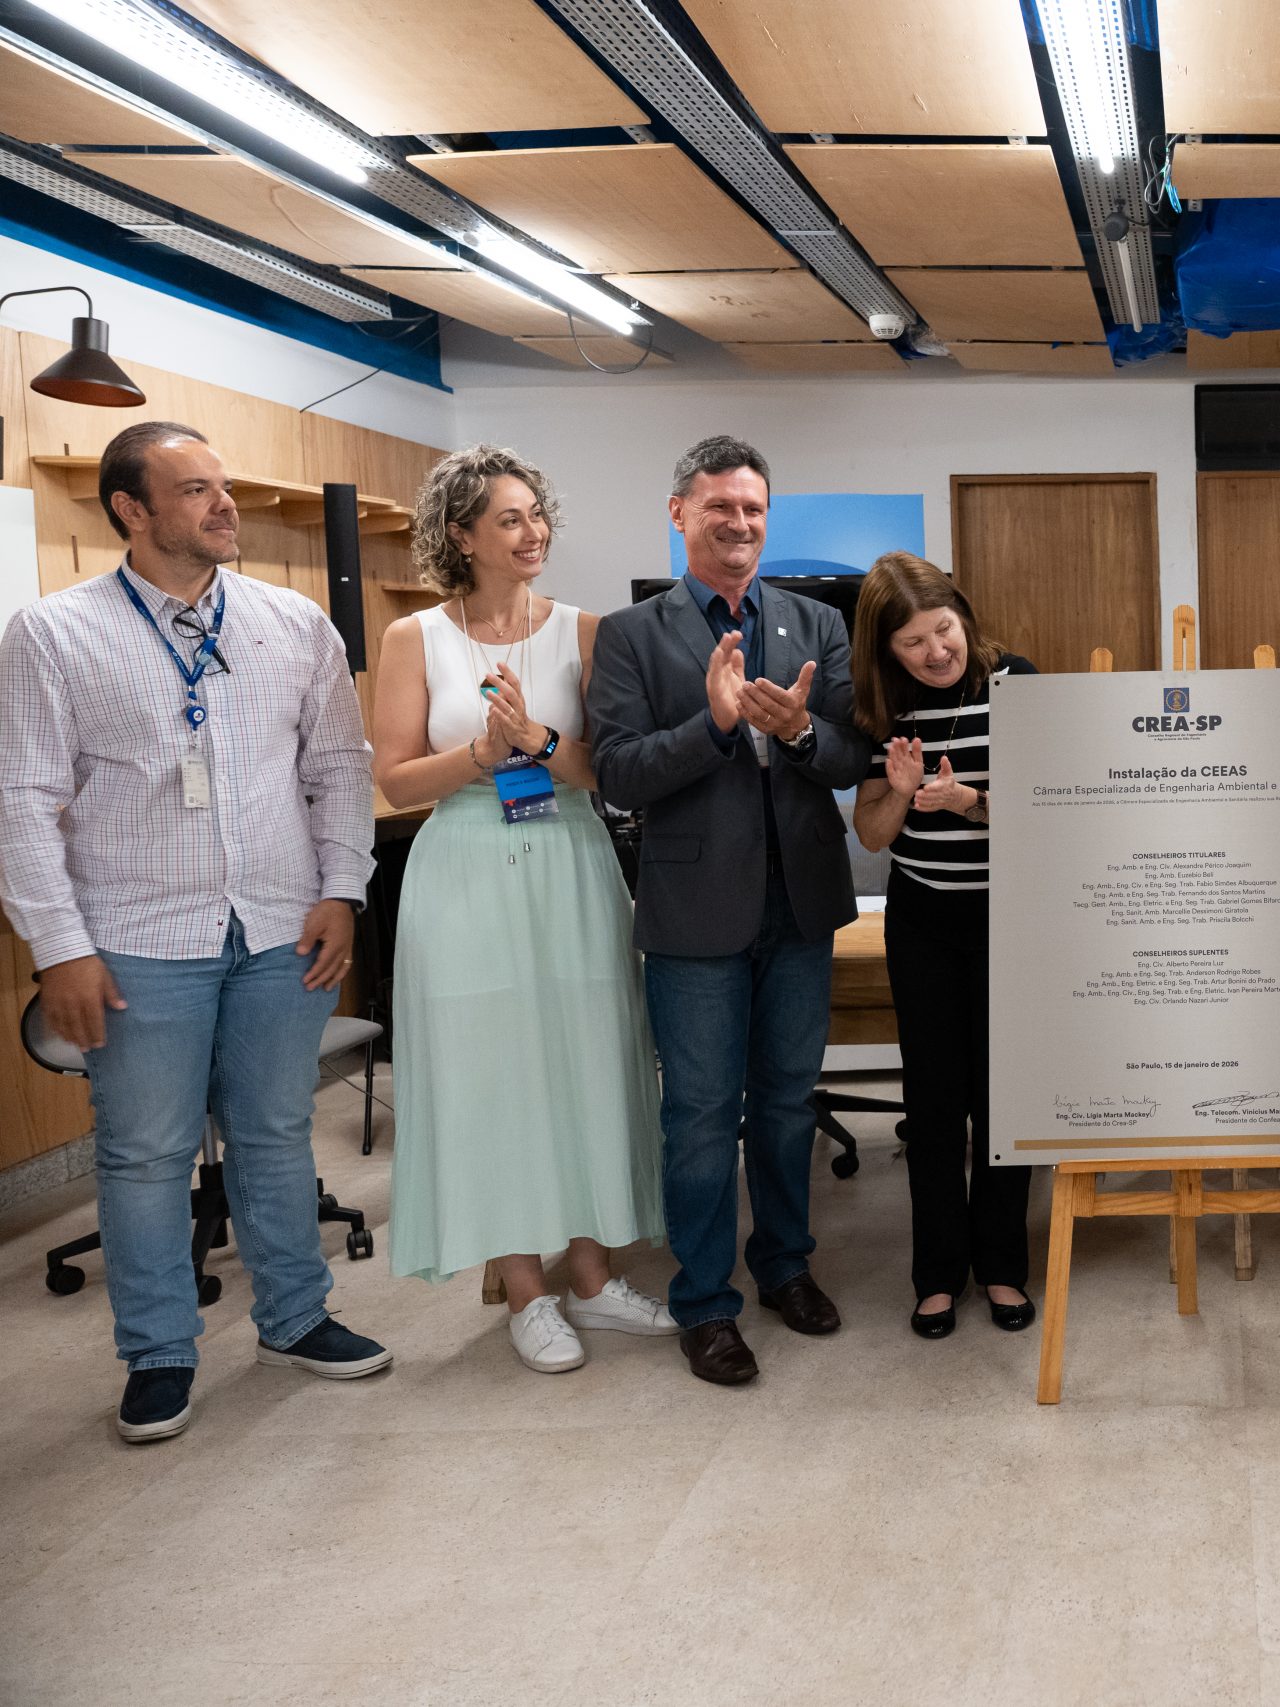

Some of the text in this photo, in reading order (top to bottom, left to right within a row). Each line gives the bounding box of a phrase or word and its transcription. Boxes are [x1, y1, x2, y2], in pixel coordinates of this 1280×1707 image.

[1132, 714, 1222, 732] CREA-SP
[1109, 765, 1248, 781] Instalação da CEEAS
[1033, 786, 1071, 795] Câmara
[1075, 784, 1141, 794] Especializada
[1145, 784, 1157, 792] de
[1159, 783, 1215, 793] Engenharia
[1218, 782, 1268, 791] Ambiental
[1190, 987, 1203, 995] Eng.
[1184, 1061, 1210, 1069] janeiro
